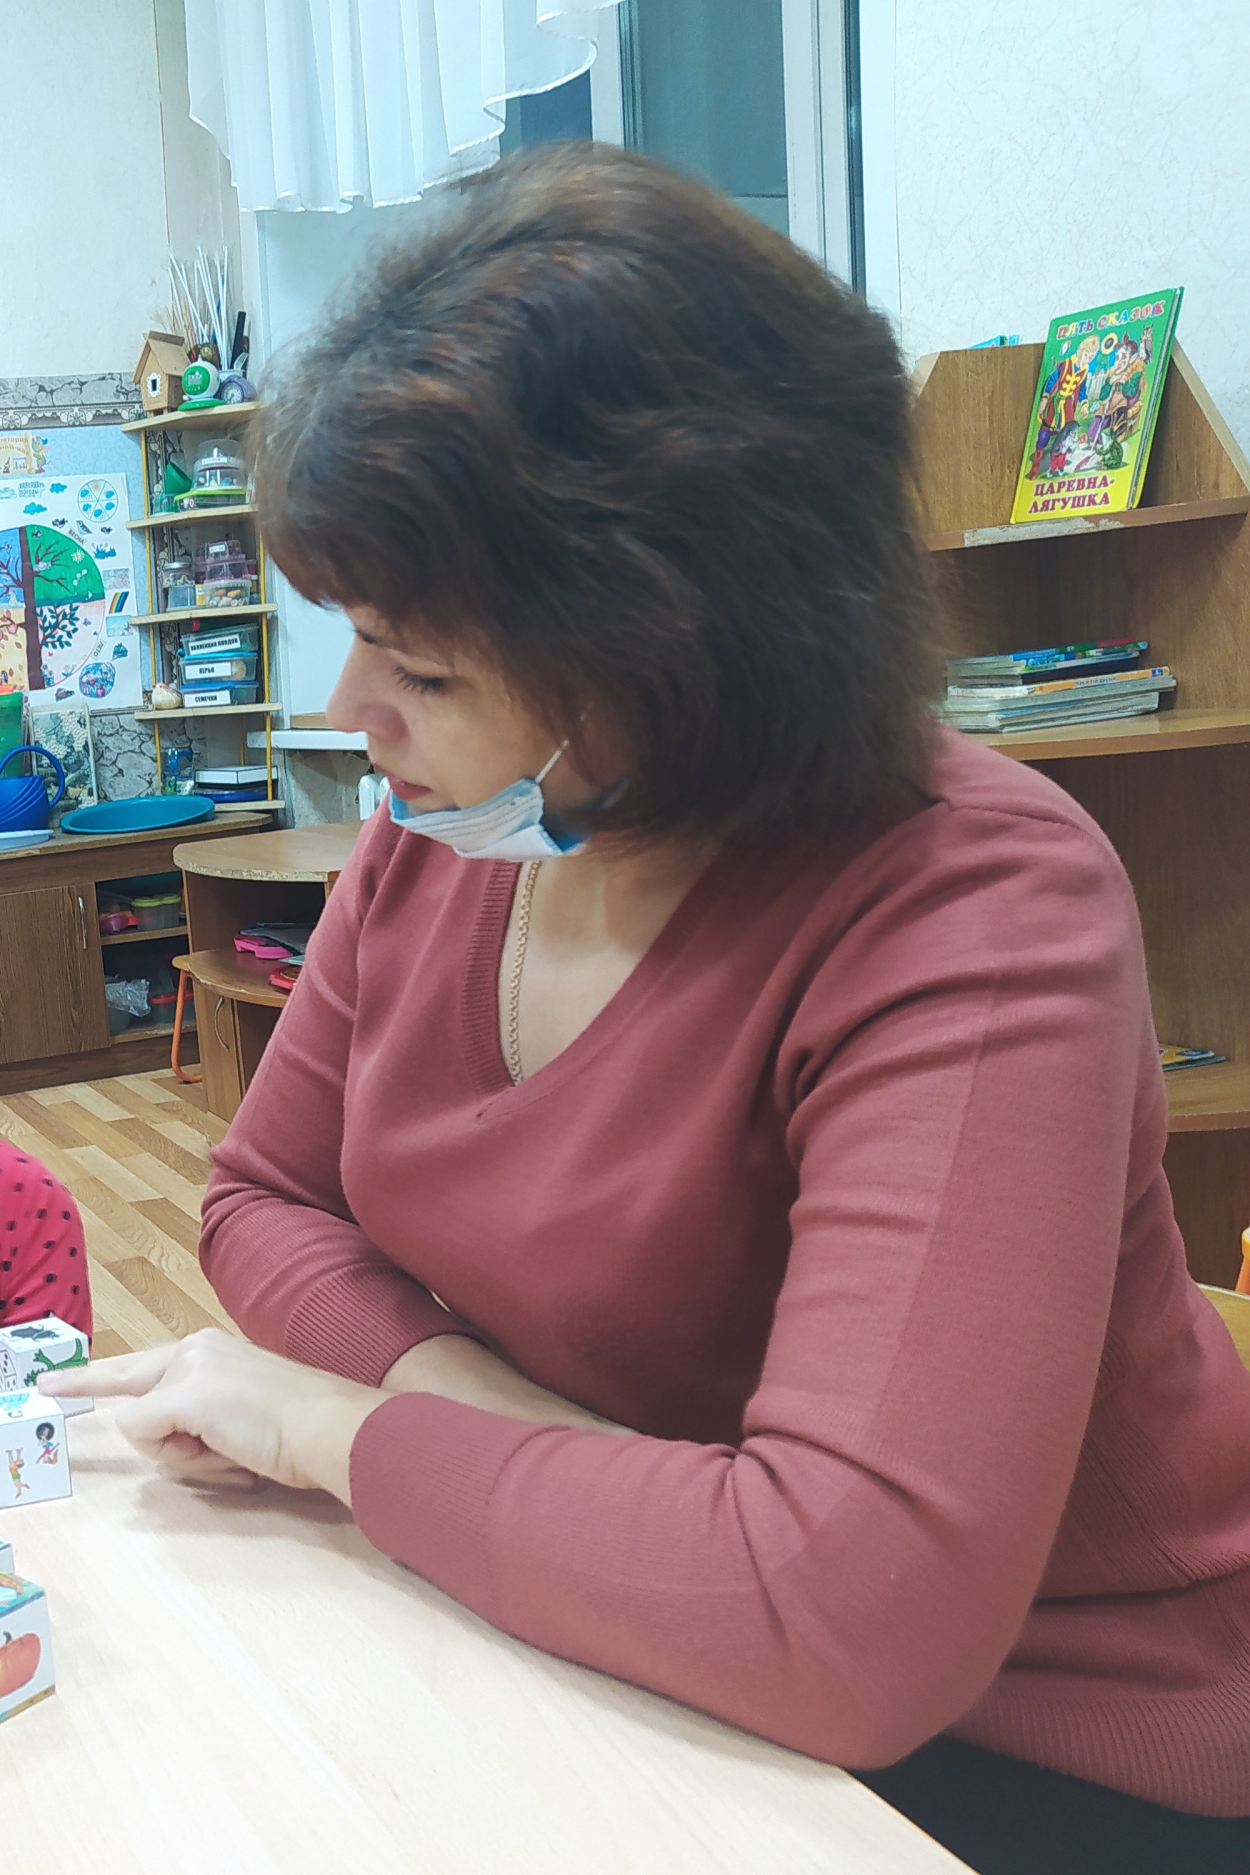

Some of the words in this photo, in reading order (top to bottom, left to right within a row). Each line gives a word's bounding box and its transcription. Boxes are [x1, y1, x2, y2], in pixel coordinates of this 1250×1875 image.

[1057, 319, 1094, 339] ПЯТЬ
[1098, 300, 1166, 329] СКАЗОК
[1034, 475, 1115, 497] ЦАРЕВНА-
[1028, 492, 1110, 514] ЛЯГУШКА
[68, 529, 85, 545] ВЕСНА
[93, 641, 104, 657] ЛЕТО
[190, 641, 218, 651] КОЛЛЕКЦИЯ
[198, 666, 215, 675] ПЕРЬЯ
[194, 694, 218, 703] СЕМЕЧКИ
